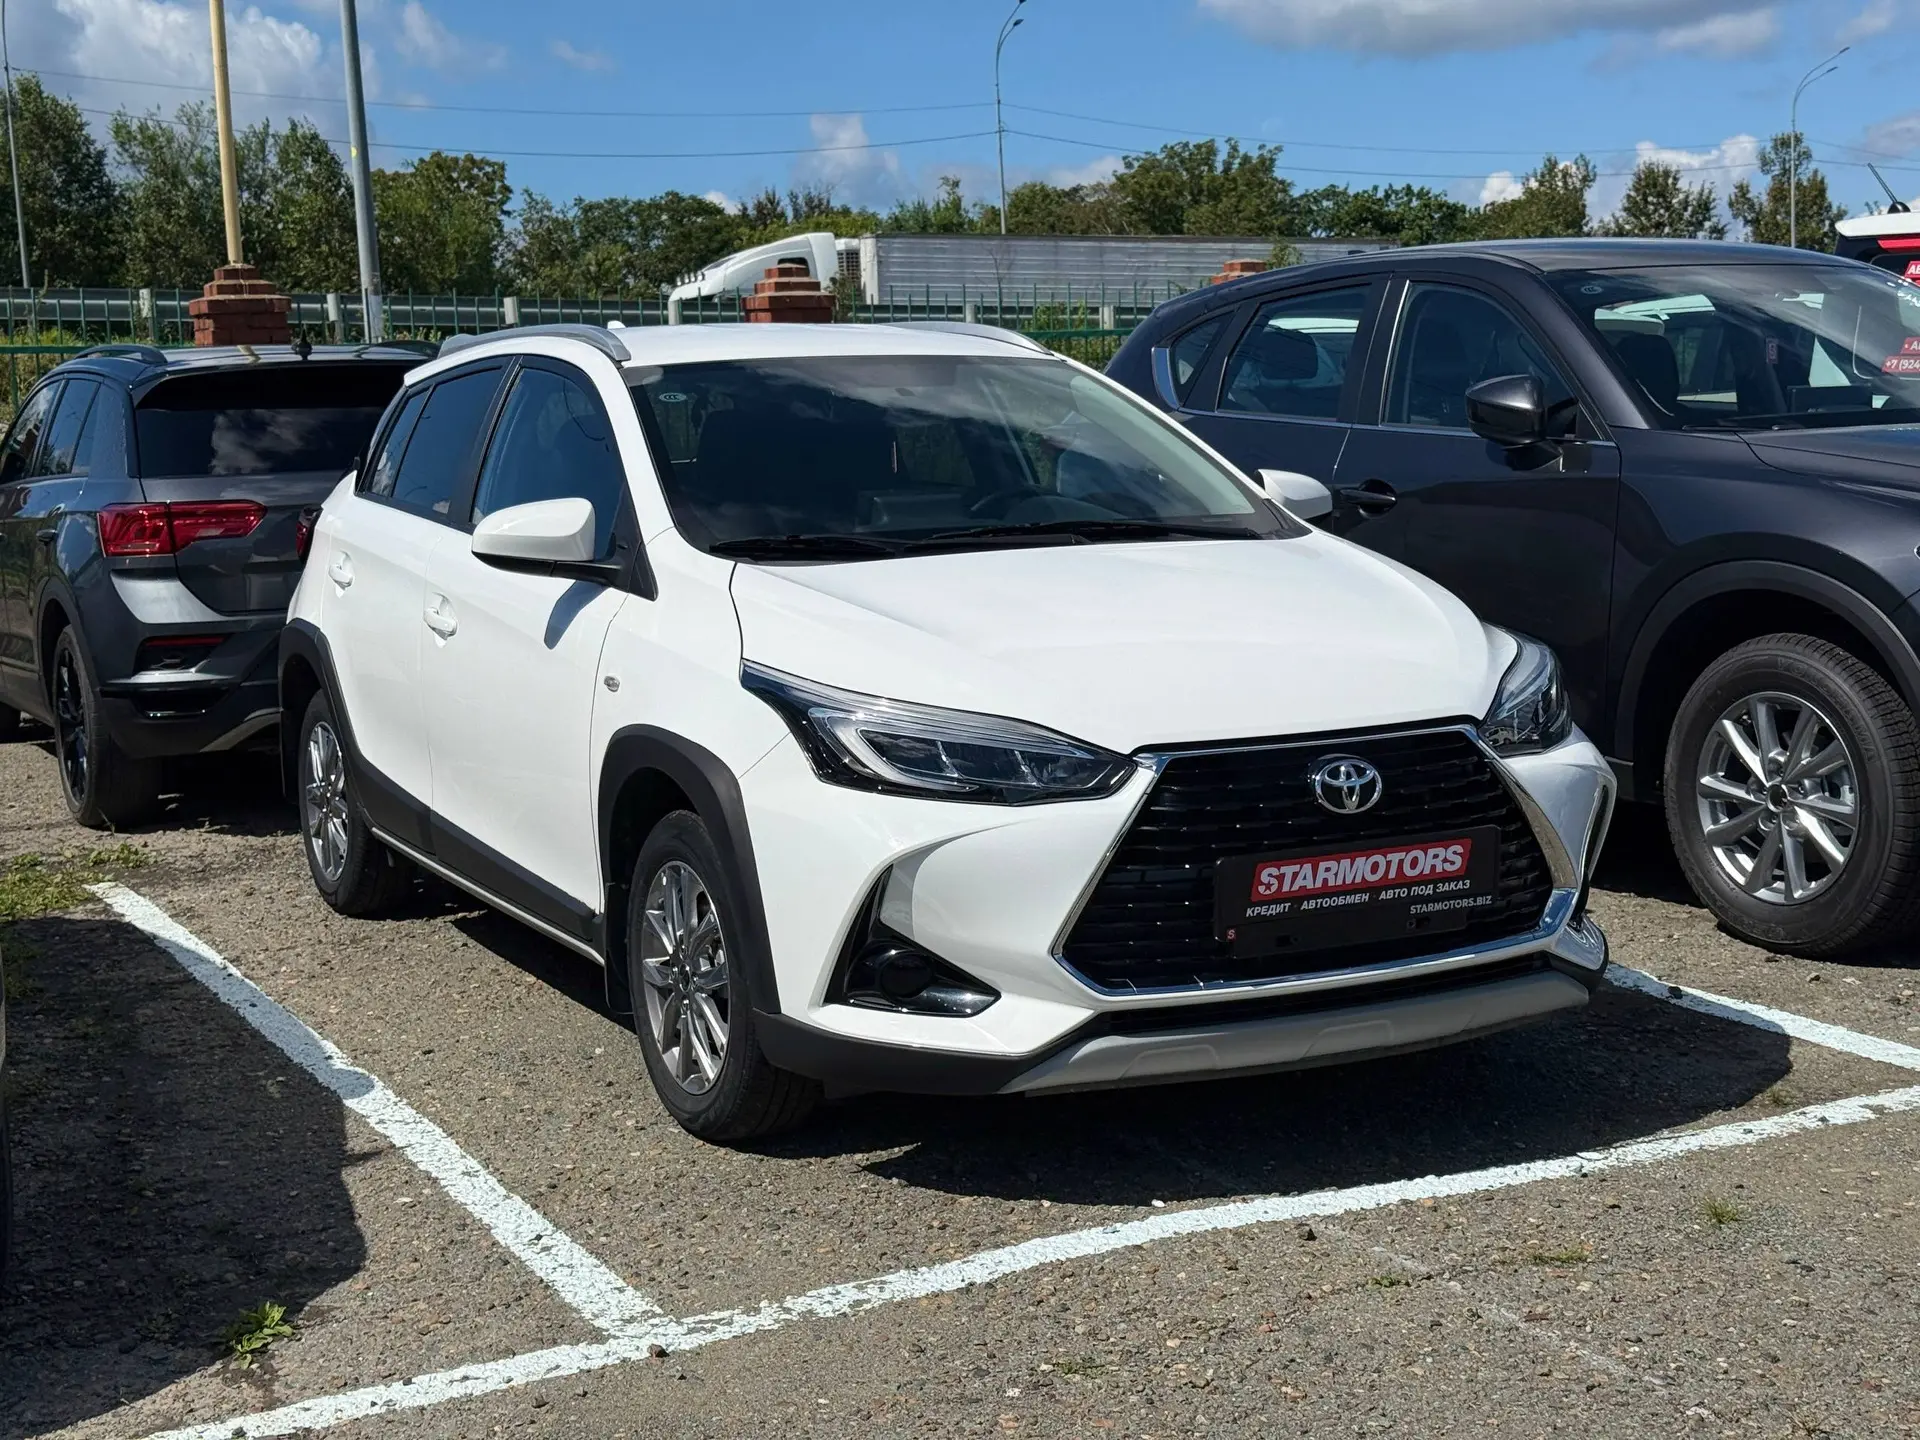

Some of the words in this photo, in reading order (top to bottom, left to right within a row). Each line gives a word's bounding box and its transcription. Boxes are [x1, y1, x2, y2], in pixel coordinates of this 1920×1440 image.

[1899, 359, 1920, 371] (924
[1258, 845, 1464, 895] STARMOTORS
[1246, 902, 1291, 917] КРЕДИТ
[1301, 893, 1369, 910] АВТООБМЕН
[1379, 888, 1408, 900] АВТО
[1411, 883, 1434, 897] ПОД
[1436, 879, 1471, 893] ЗАКАЗ
[1410, 895, 1492, 914] STARMOTORS.BIZ
